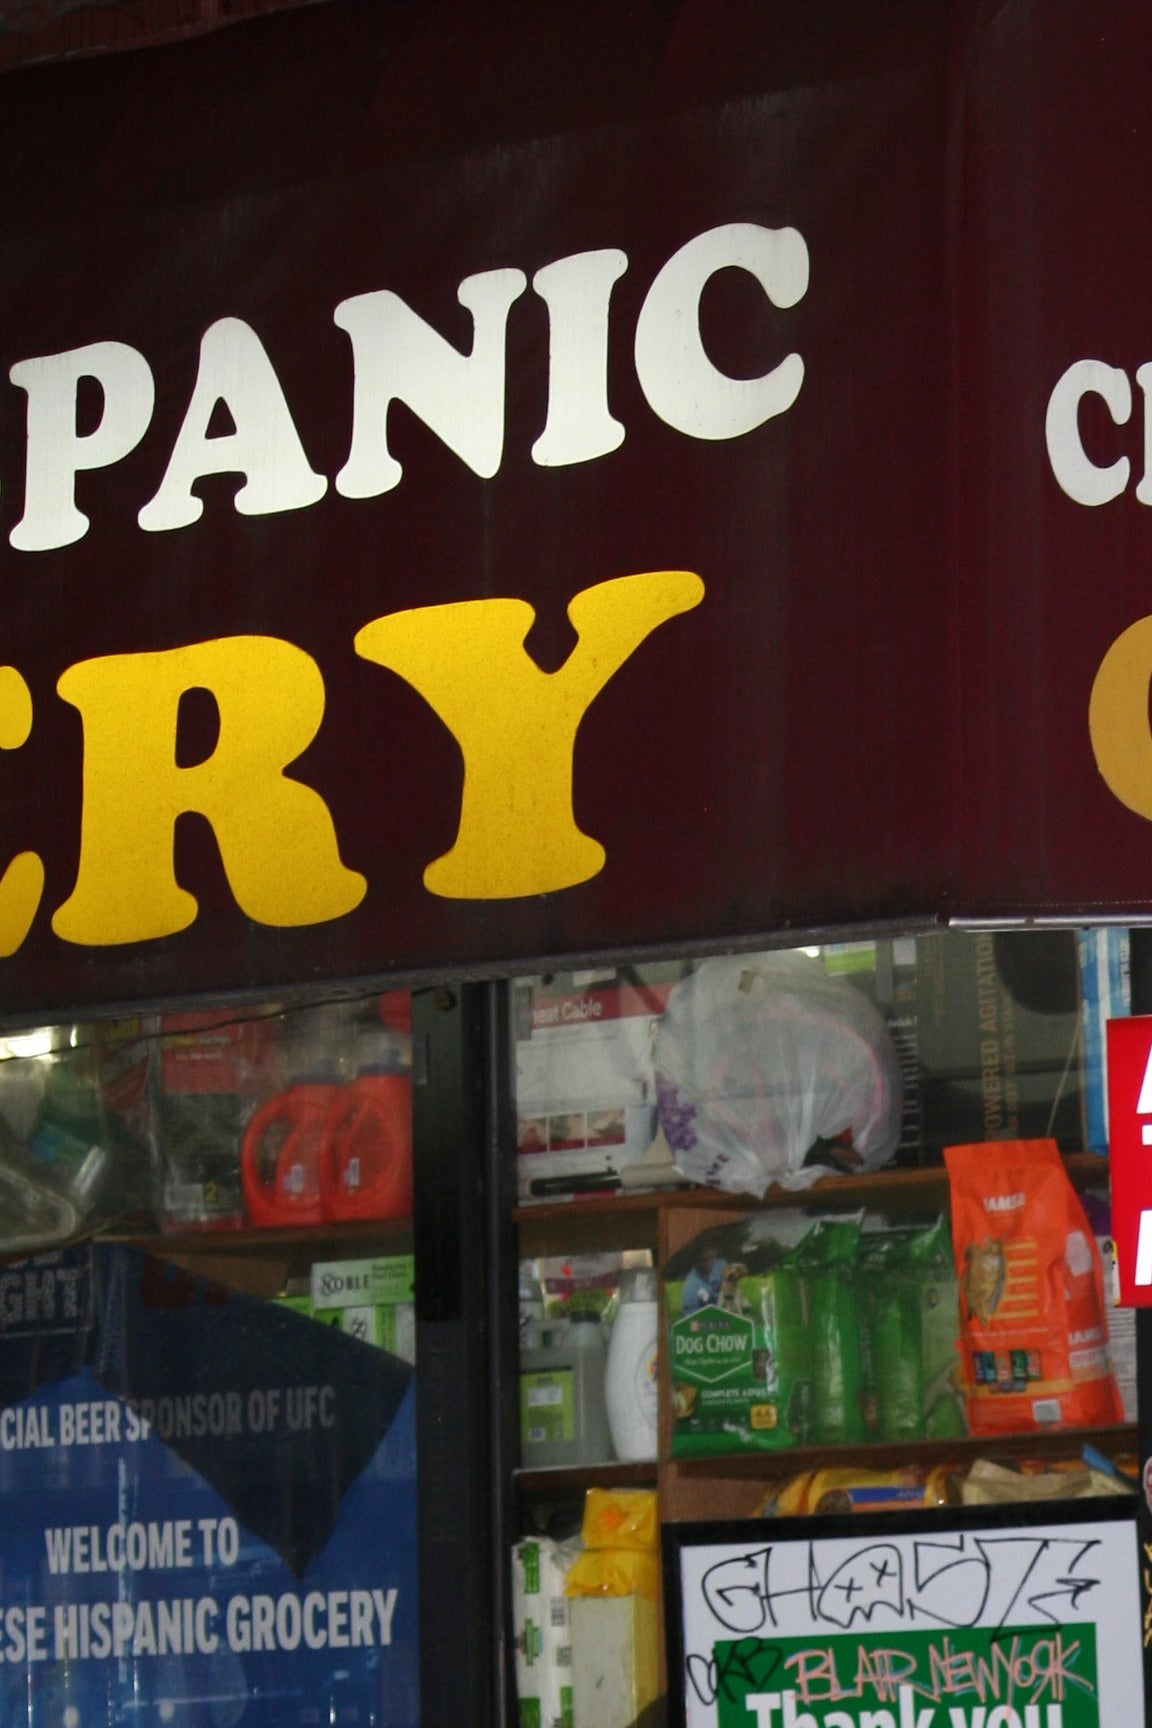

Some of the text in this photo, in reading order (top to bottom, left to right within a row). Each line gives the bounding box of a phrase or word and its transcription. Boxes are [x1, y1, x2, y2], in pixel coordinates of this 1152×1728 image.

[8, 223, 810, 552] PANIC
[562, 999, 603, 1021] Cable
[319, 1270, 370, 1296] NOBLE
[60, 1400, 121, 1445] BEER
[125, 1393, 244, 1442] SPONSOR
[248, 1389, 281, 1433] OF
[286, 1385, 336, 1430] UFC
[44, 1516, 240, 1576] WELCOME TO
[0, 1588, 399, 1664] SE HISPANIC GROCERY
